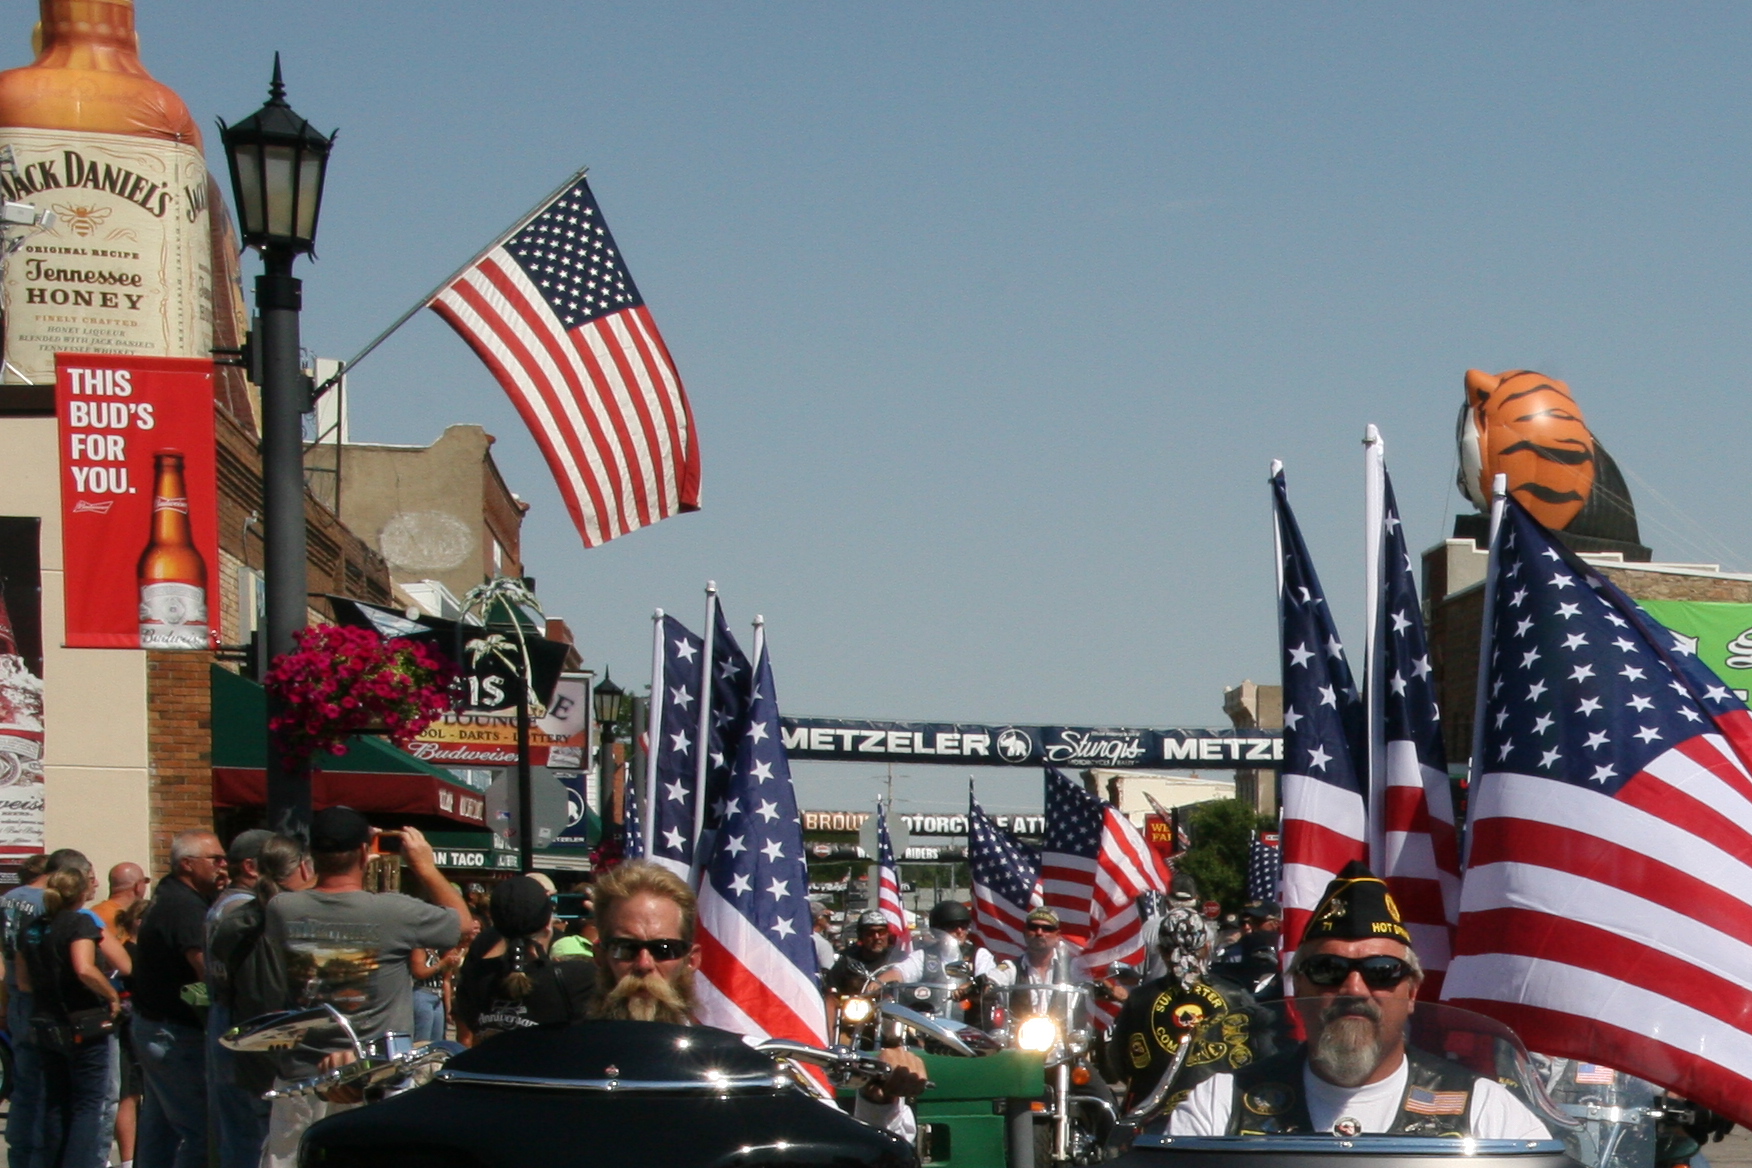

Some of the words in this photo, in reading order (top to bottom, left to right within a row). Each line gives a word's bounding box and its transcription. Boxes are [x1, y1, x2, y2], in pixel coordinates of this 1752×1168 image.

[1, 160, 62, 201] JACK
[63, 150, 173, 218] DANIEL'S
[26, 246, 88, 256] ORIGINAL
[92, 249, 140, 260] RECIPE
[26, 258, 143, 287] Tennessee
[26, 288, 144, 310] HONEY
[35, 315, 77, 323] FINELY
[83, 317, 138, 327] CRAFTED
[67, 368, 132, 396] THIS
[70, 401, 154, 430] BUD'S
[71, 434, 125, 461] FOR
[71, 466, 137, 494] YOU.
[419, 729, 446, 739] OOL
[459, 730, 500, 741] DARTS
[513, 733, 571, 744] LTTERY
[781, 727, 990, 757] METZELER
[1046, 731, 1146, 766] Sturgis
[451, 853, 484, 867] TACO
[1372, 922, 1393, 933] HOT
